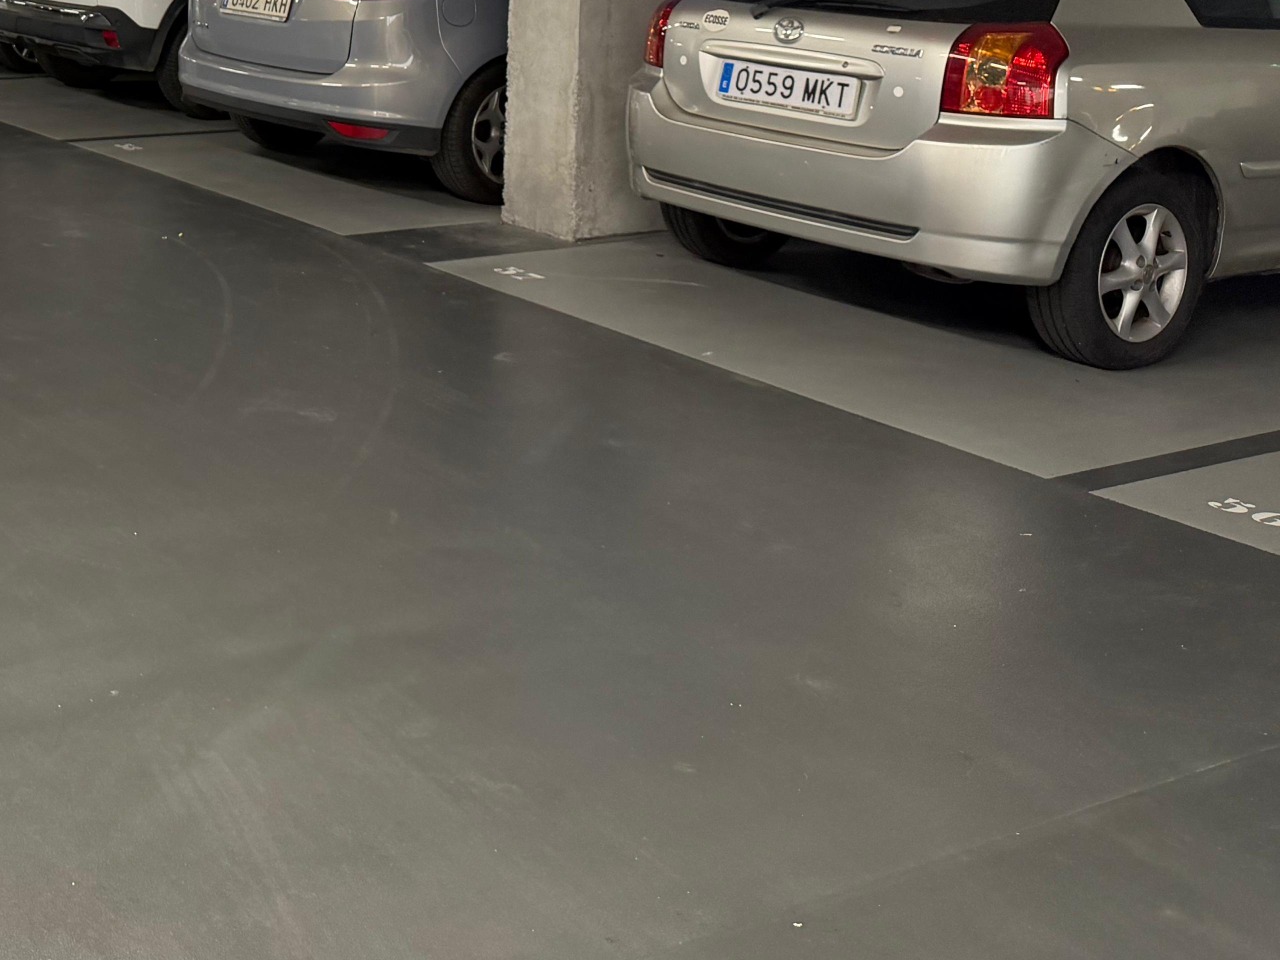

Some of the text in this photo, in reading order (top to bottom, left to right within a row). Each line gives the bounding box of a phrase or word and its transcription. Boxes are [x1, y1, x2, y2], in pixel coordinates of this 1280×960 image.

[704, 13, 729, 26] ECOSSE
[735, 67, 795, 99] 0559
[802, 77, 851, 109] MKT
